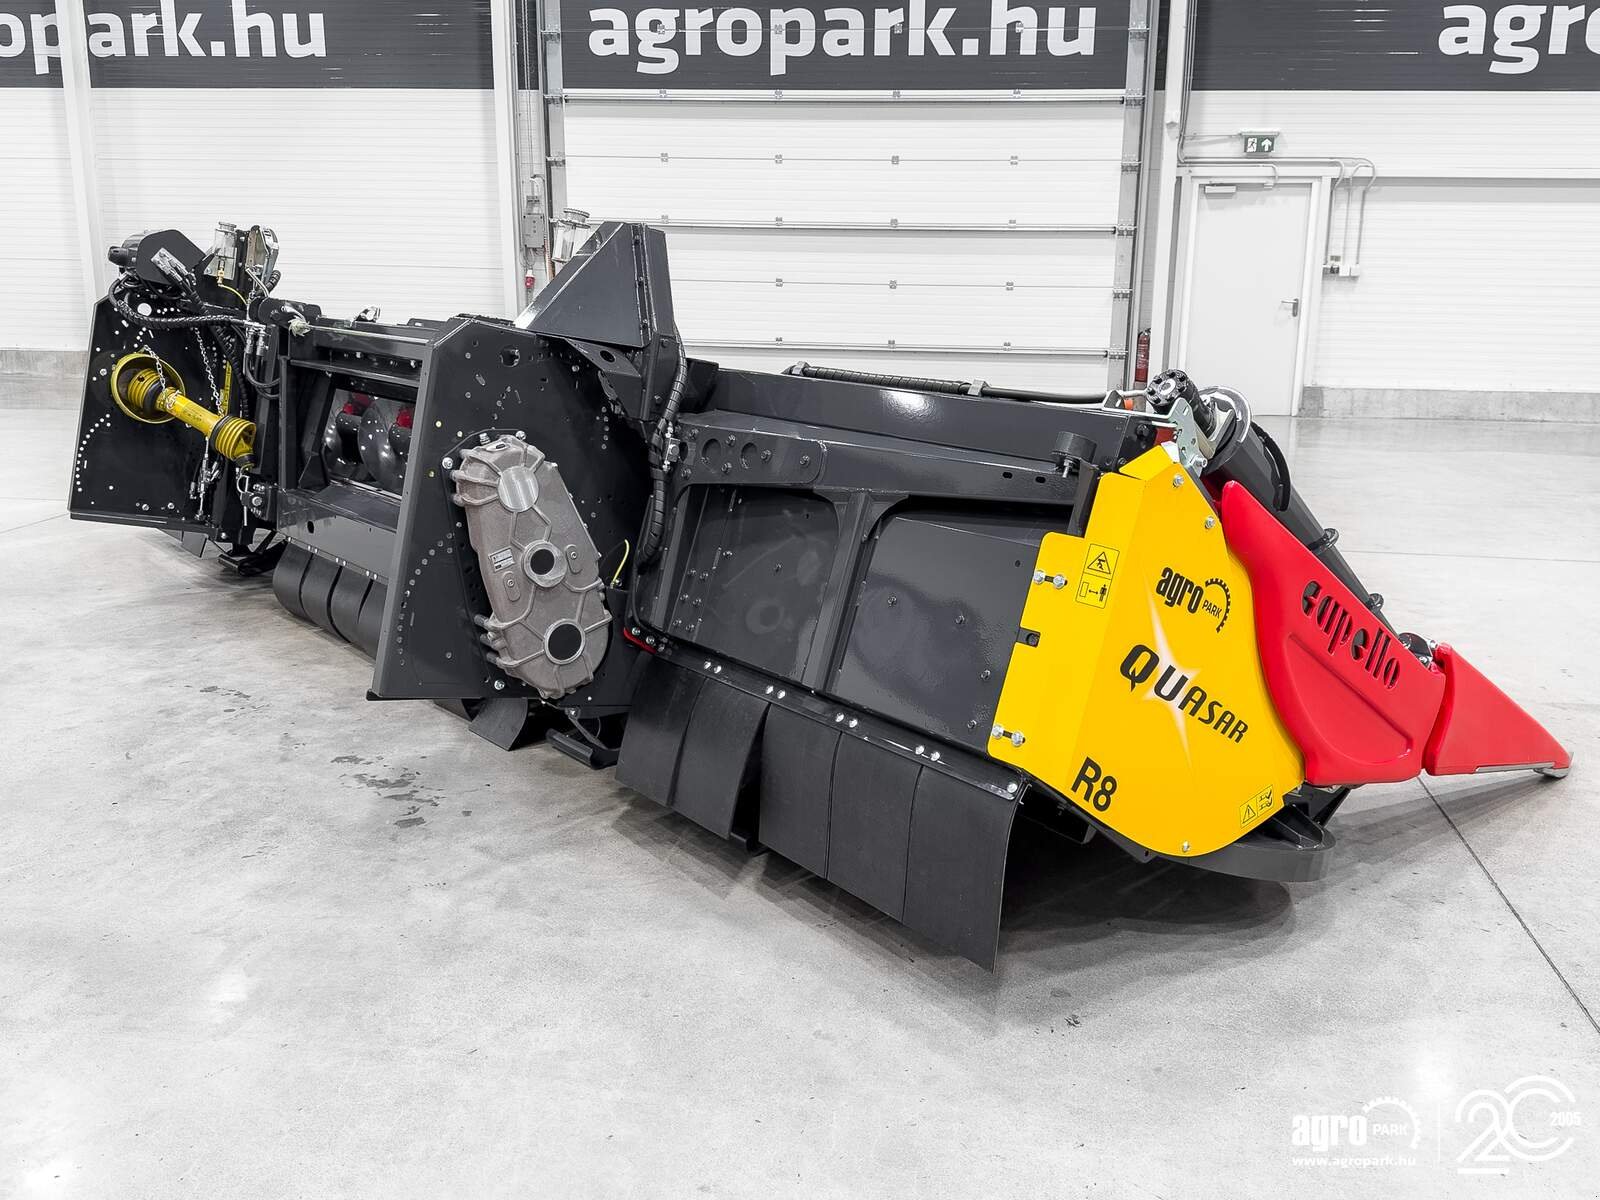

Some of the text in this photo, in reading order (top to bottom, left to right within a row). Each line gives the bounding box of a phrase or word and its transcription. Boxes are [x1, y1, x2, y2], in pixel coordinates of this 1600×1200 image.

[588, 0, 1096, 76] agropark.hu
[1156, 567, 1222, 619] agro PARK
[1302, 580, 1400, 690] capello
[1120, 644, 1249, 743] QUASAR
[1071, 756, 1118, 812] R8
